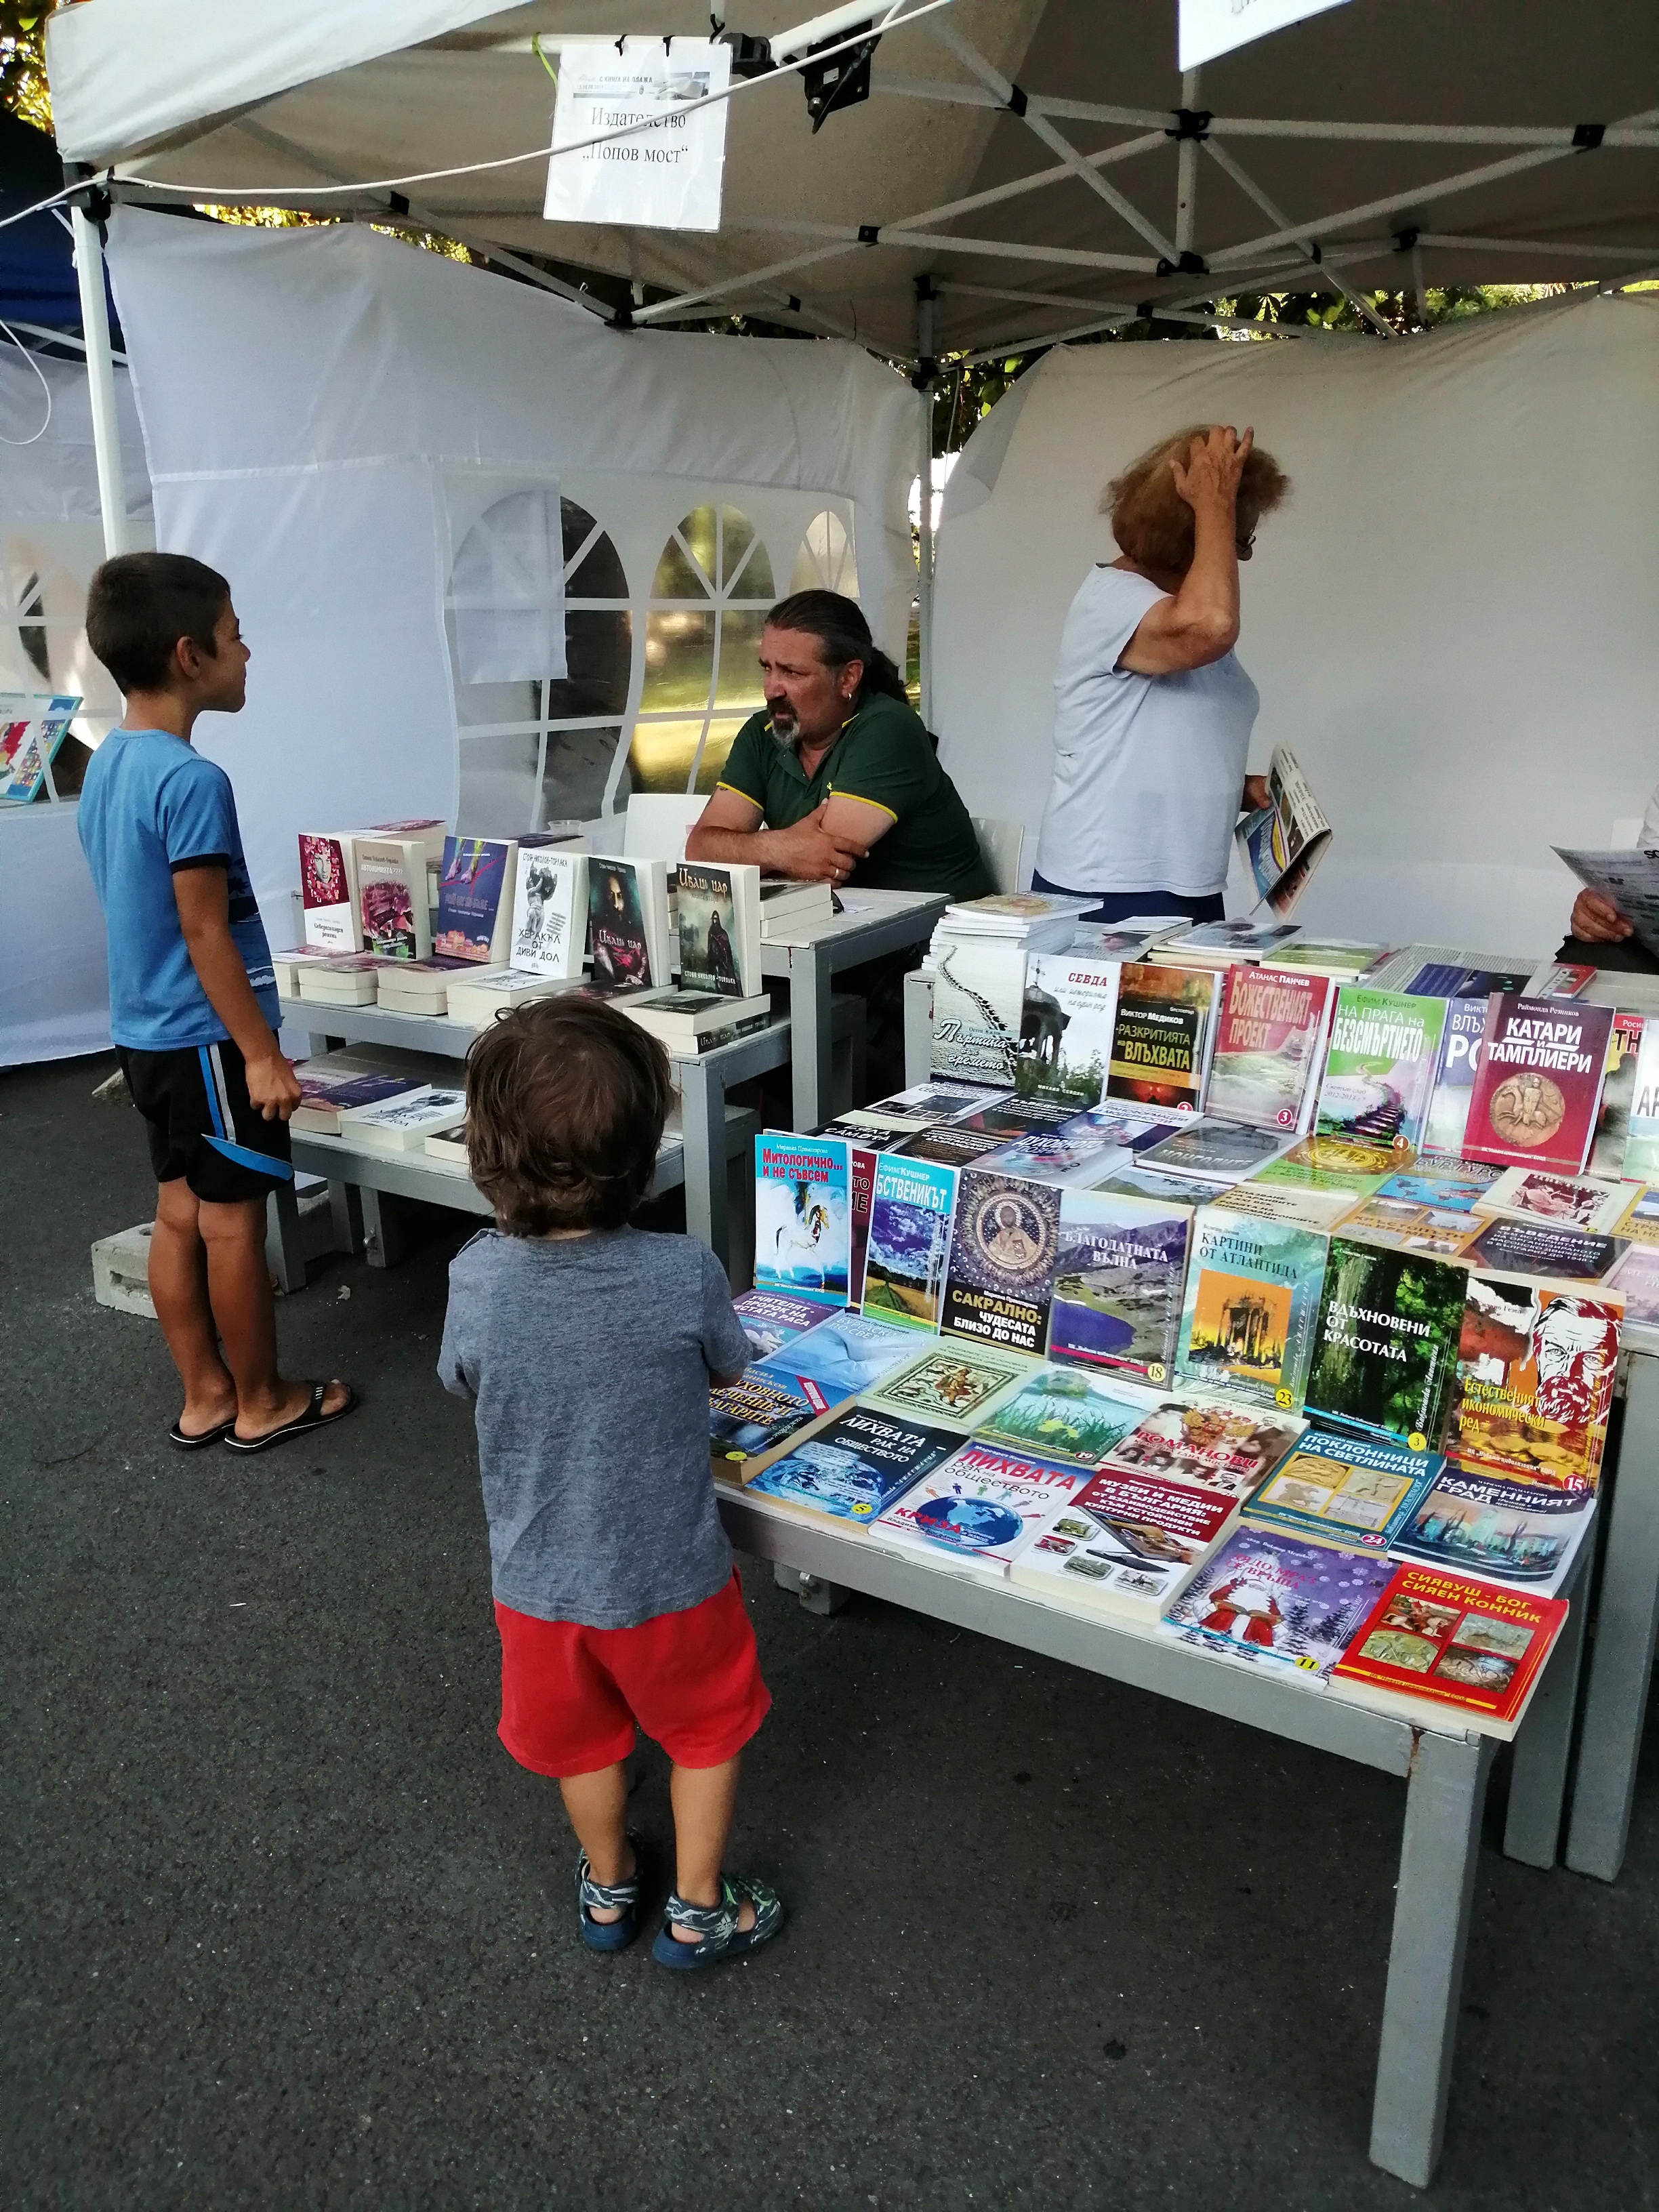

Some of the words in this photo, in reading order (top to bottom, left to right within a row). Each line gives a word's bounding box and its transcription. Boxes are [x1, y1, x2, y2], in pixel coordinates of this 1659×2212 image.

[519, 928, 560, 944] ХЕРАКЪЛ
[532, 941, 544, 949] ОТ
[516, 947, 536, 958] ДИВИ
[539, 951, 560, 962] ДОЛ
[1068, 972, 1107, 987] СЕВДА
[1279, 975, 1310, 987] ПАНЧЕВ
[1228, 972, 1313, 1025] БОЖЕСТВЕНИЯТ
[1338, 1004, 1360, 1018] НА
[1361, 1007, 1405, 1025] ПРАГА
[1409, 1015, 1425, 1027] на
[1118, 1023, 1191, 1046] РАЗКРИТИЯТА
[1229, 1019, 1271, 1049] ПРОЕКТ
[1332, 1018, 1424, 1063] БЕЗСМЪРТИЕТО
[1507, 1018, 1583, 1045] КАТАРИ
[1124, 1040, 1191, 1070] ВЛЪХВАТА
[1488, 1042, 1593, 1073] ТАМПЛИЕРИ
[1280, 1111, 1288, 1122] 3
[1396, 1138, 1404, 1149] 4
[762, 1148, 844, 1171] Митологично...
[762, 1166, 769, 1177] и
[773, 1168, 786, 1179] не
[788, 1169, 830, 1183] съвсем
[1065, 1232, 1168, 1263] БЛАГОДАТНАТА
[1202, 1232, 1263, 1255] КАРТИНИ
[1499, 1225, 1607, 1249] ВЪВЕДЕНИЕ
[1092, 1251, 1137, 1270] ВЪЛНА
[1200, 1246, 1215, 1258] ОТ
[1220, 1252, 1297, 1279] АТЛАНТИДА
[748, 1295, 811, 1312] УЧИТЕЛЯТ
[788, 1309, 807, 1319] НА
[952, 1289, 1042, 1325] САКРАЛНО:
[777, 1313, 811, 1327] РАСА
[828, 1322, 848, 1331] ПО
[979, 1311, 1037, 1337] ЧУДЕСАТА
[1326, 1315, 1346, 1330] ОТ
[1328, 1300, 1431, 1338] ВДЪХНОВЕНИ
[953, 1317, 991, 1336] БЛИЗО
[992, 1328, 1010, 1341] ДО
[1012, 1332, 1036, 1349] НАС
[1324, 1329, 1407, 1363] КРАСОТАТА
[1150, 1366, 1163, 1378] 18
[1277, 1392, 1292, 1404] 23
[1459, 1416, 1480, 1433] ред
[1462, 1397, 1545, 1429] икономически
[840, 1416, 926, 1448] ЛИХВАТА
[1413, 1437, 1420, 1446] 3
[834, 1437, 910, 1464] ОБЩЕСТВОТО
[870, 1437, 897, 1450] РАК
[897, 1445, 916, 1456] НА
[1078, 1452, 1092, 1460] 19
[1136, 1431, 1259, 1469] РОМАНОВИ
[1298, 1441, 1322, 1454] НА
[1324, 1447, 1427, 1477] СВЕТЛИНАТА
[1303, 1434, 1429, 1468] ПОКЛОННИЦИ
[952, 1460, 981, 1474] рак
[983, 1470, 996, 1478] на
[958, 1450, 1078, 1490] ЛИХВАТА
[945, 1467, 1050, 1500] обществото
[1098, 1477, 1151, 1495] МУЗЕИ
[1153, 1488, 1165, 1498] И
[1166, 1491, 1225, 1515] МЕДИИ
[1435, 1483, 1492, 1506] ГРАД
[1440, 1476, 1578, 1507] КАМЕННИЯТ
[1567, 1478, 1583, 1491] 15
[1091, 1490, 1106, 1499] ОТ
[1107, 1494, 1212, 1526] ВЗАИМОДЕЙСТВИЕ
[1099, 1498, 1122, 1509] КЪМ
[1124, 1504, 1195, 1528] УСТОЙЧИВИ
[1104, 1486, 1115, 1495] В
[1119, 1488, 1207, 1518] БЪЛГАРИЯ:
[894, 1507, 962, 1534] КРИЗА
[1084, 1500, 1139, 1521] КУЛТУРНИ
[1141, 1515, 1202, 1536] ПРОДУКТИ
[1366, 1536, 1383, 1546] 24
[1401, 1580, 1459, 1602] СИЯЕН
[1462, 1597, 1544, 1624] КОННИК
[1406, 1571, 1481, 1598] СИЯВУШ
[1496, 1595, 1533, 1609] БОГ
